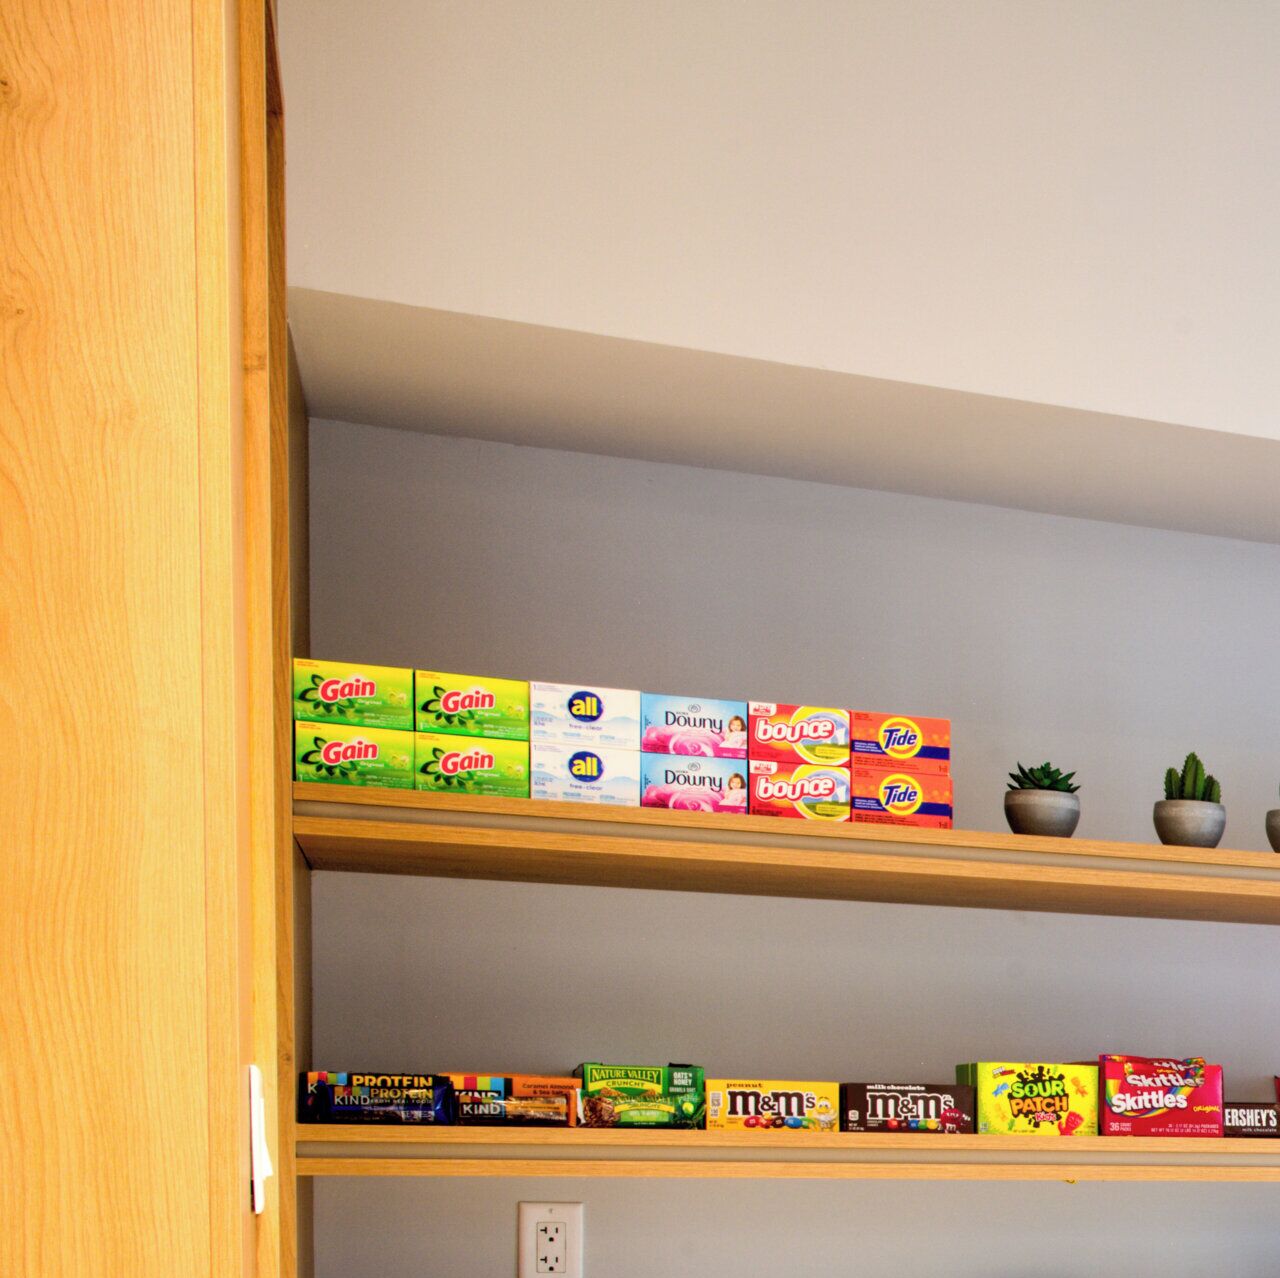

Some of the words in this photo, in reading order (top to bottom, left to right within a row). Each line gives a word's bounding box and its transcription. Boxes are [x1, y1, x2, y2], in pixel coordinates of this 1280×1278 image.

[320, 678, 375, 702] Gain
[442, 690, 494, 712] Gain
[571, 697, 598, 716] all
[665, 711, 723, 734] Downy
[757, 719, 833, 742] bounce
[883, 728, 917, 750] Tide
[322, 740, 378, 765] Gain
[441, 751, 494, 774] Gain
[572, 757, 598, 776] all
[665, 770, 722, 792] Downy
[758, 778, 833, 800] bounce
[883, 785, 917, 806] Tide
[352, 1075, 433, 1087] PROTEIN
[592, 1069, 626, 1080] NATURE
[628, 1069, 658, 1083] VALLEY
[1126, 1073, 1205, 1087] Skittles
[370, 1088, 433, 1099] PROTEIN
[1012, 1081, 1064, 1097] SOUR
[334, 1095, 369, 1105] KIND
[463, 1104, 500, 1114] KIND
[1011, 1096, 1068, 1116] PATCH
[1111, 1090, 1188, 1114] Skittles
[1110, 1122, 1120, 1131] 36
[1224, 1108, 1277, 1127] ERSHEY'S
